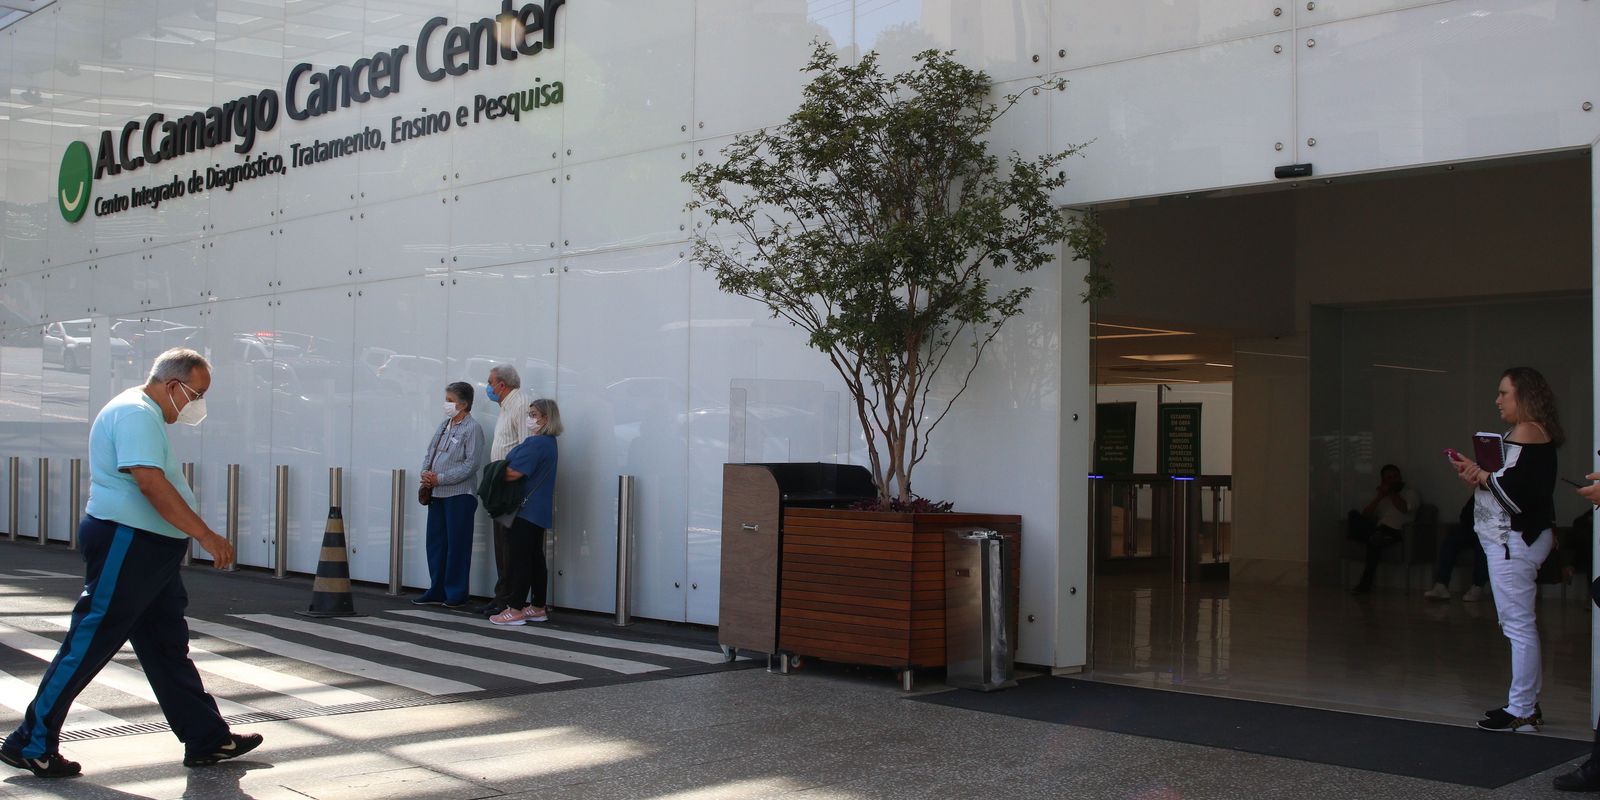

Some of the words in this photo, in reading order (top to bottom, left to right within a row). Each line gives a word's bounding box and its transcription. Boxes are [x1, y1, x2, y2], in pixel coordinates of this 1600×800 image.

[94, 89, 279, 179] A.C.Camargo
[285, 45, 409, 120] Cancer
[416, 0, 565, 82] Center
[94, 193, 129, 217] Centro
[131, 174, 185, 209] Integrado
[188, 170, 203, 194] de
[206, 151, 286, 191] Diagnóstico,
[290, 126, 386, 168] Tratamento,
[391, 107, 450, 143] Ensino
[456, 105, 469, 128] e
[474, 77, 564, 123] Pesquisa
